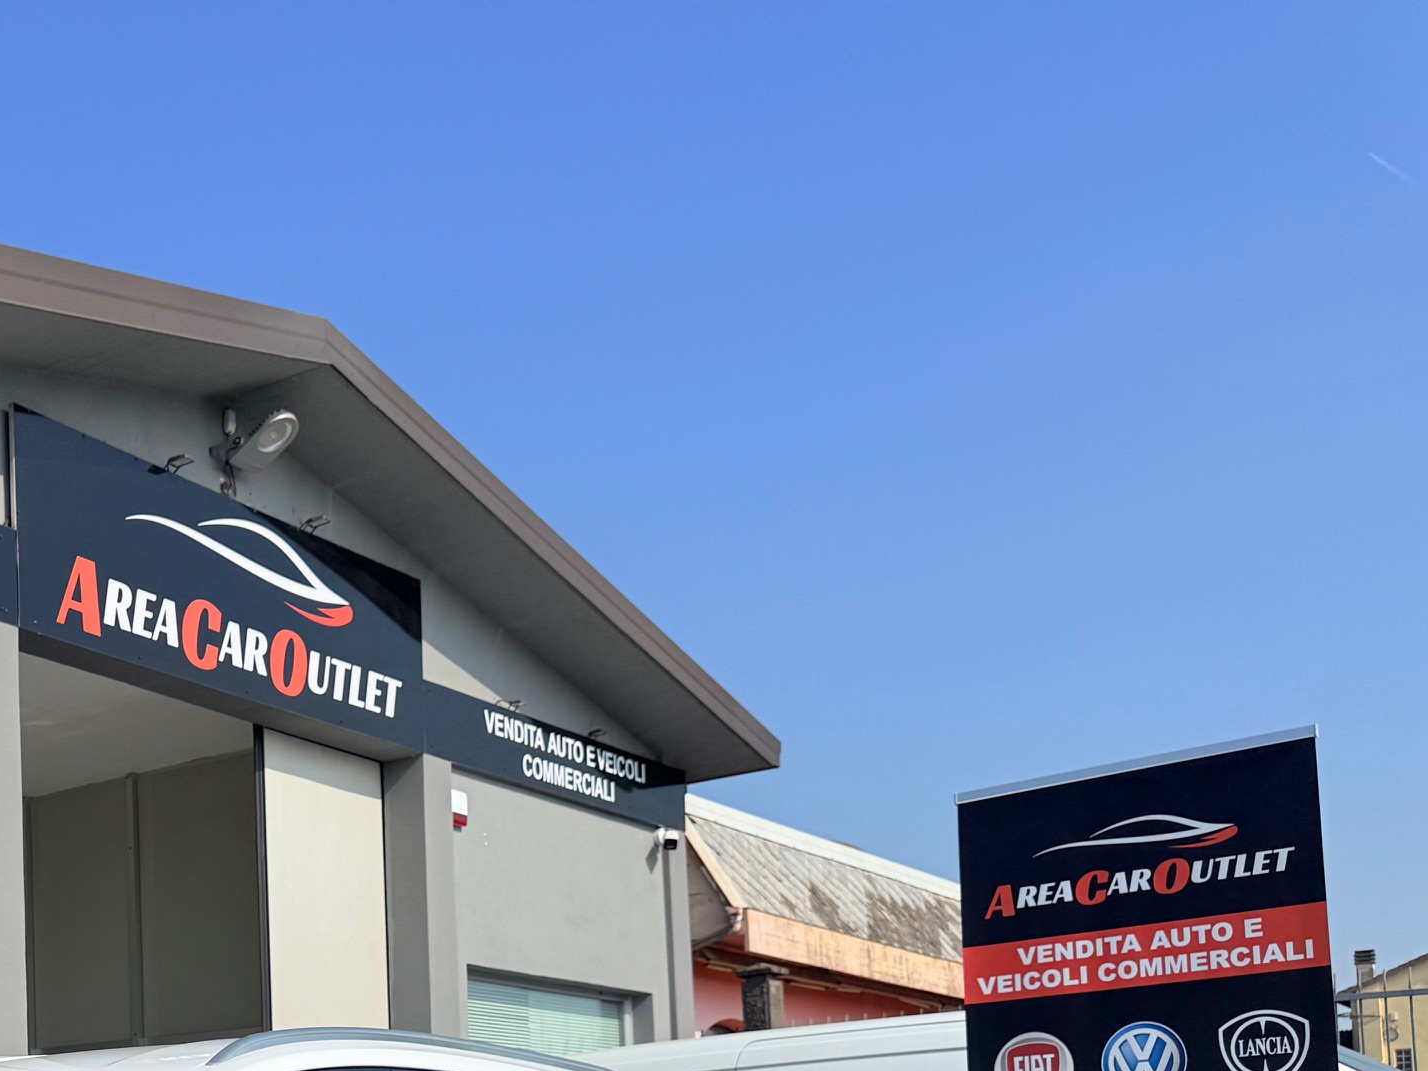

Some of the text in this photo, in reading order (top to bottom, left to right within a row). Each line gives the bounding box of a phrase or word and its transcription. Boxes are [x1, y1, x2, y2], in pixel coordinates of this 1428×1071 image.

[483, 709, 646, 784] VENDITA AUTO E VEICOLI
[522, 754, 615, 803] COMMERCIALI
[1017, 917, 1264, 966] VENDITA AUTO E
[977, 939, 1314, 996] VEICOLI COMMERCIALI
[1238, 1037, 1293, 1058] LANCIA
